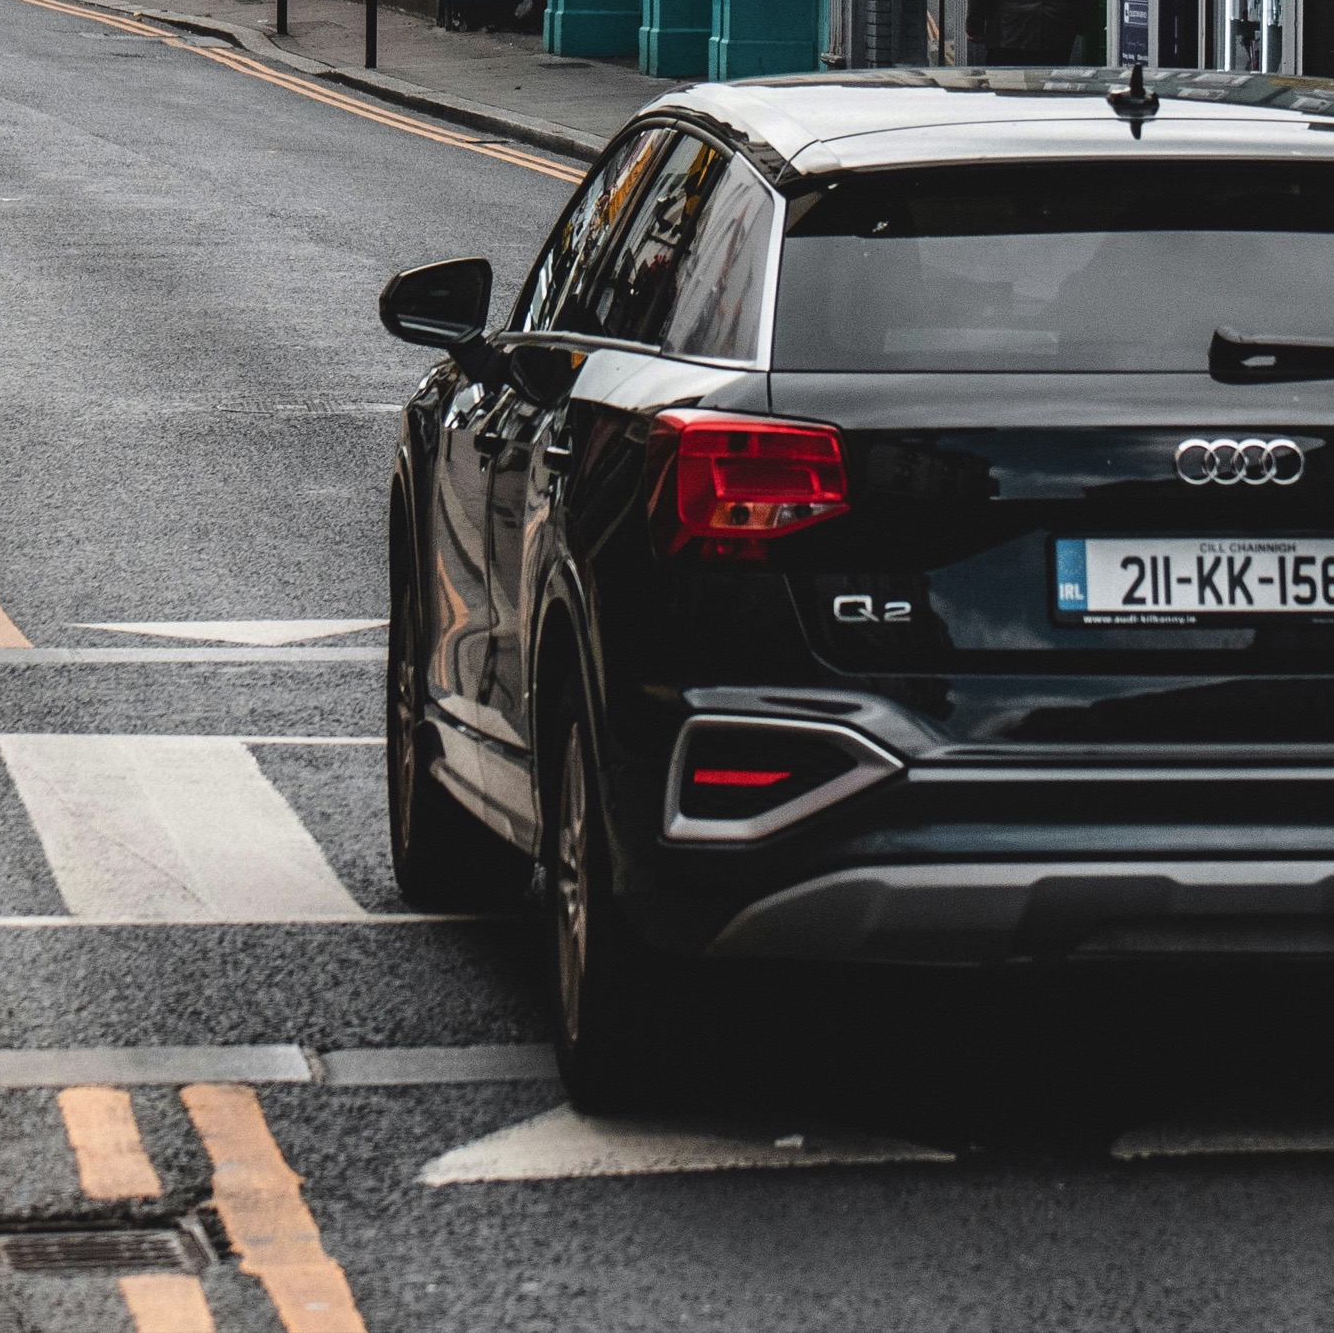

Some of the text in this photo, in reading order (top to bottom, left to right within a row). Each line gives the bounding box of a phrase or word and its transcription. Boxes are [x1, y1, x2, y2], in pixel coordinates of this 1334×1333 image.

[1199, 542, 1296, 553] CILL CHAINNIGH
[1059, 582, 1085, 601] IRL
[833, 594, 912, 622] Q2
